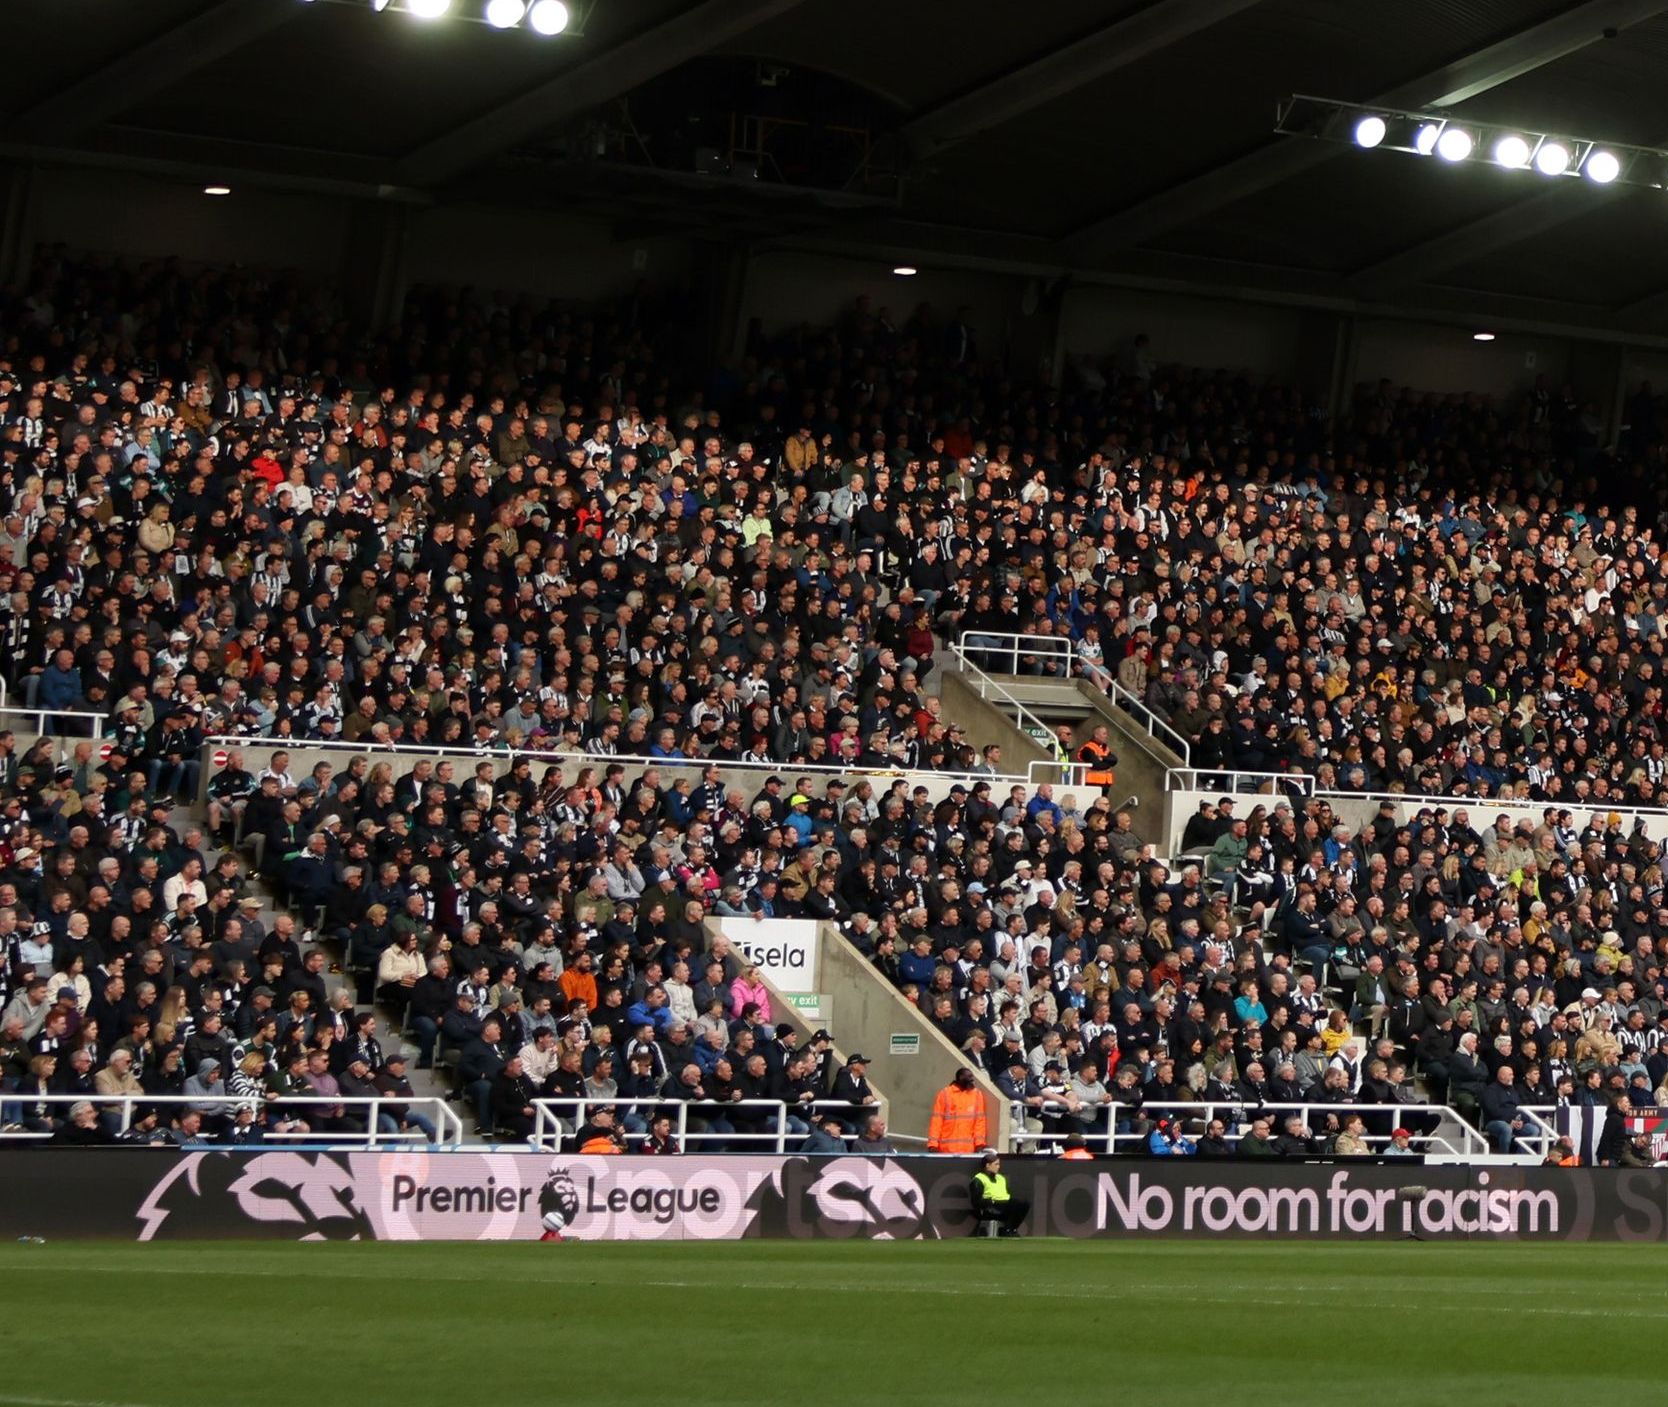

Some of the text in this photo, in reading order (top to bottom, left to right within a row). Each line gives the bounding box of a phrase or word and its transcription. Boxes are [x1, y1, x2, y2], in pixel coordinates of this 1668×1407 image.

[753, 941, 805, 968] sela
[799, 994, 817, 1006] exit
[393, 1174, 719, 1225] Premier League
[1098, 1170, 1558, 1233] No room for racism
